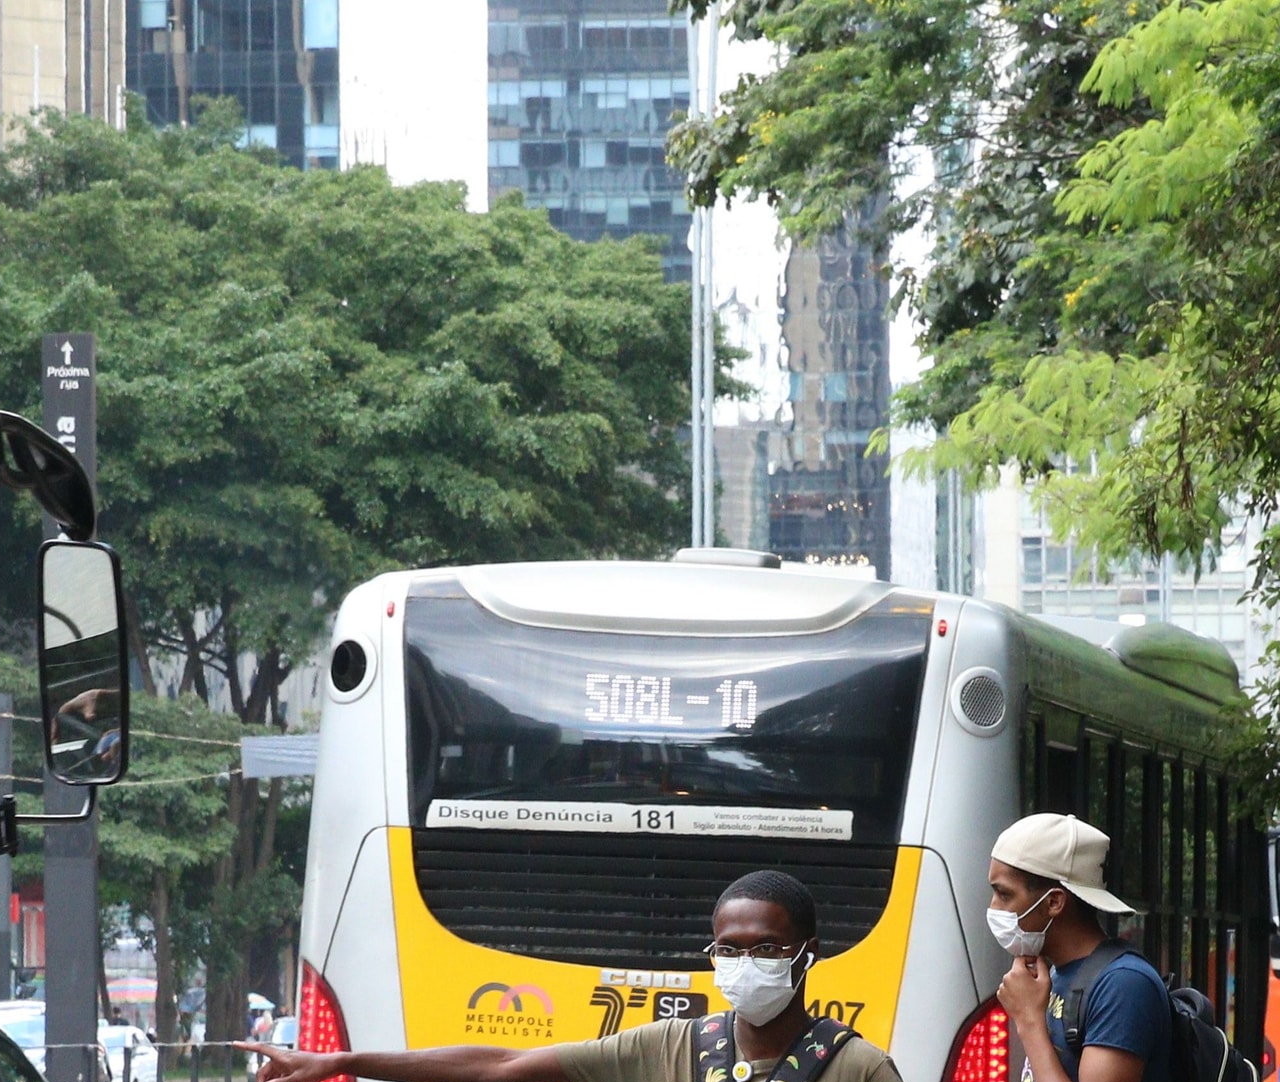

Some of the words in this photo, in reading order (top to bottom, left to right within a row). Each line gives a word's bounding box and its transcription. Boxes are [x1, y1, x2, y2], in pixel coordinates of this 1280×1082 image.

[46, 365, 91, 378] Próxima
[438, 804, 509, 823] Disque
[516, 806, 614, 824] Denúncia
[631, 809, 677, 831] 181
[714, 811, 740, 821] Vamos
[742, 813, 779, 822] combater
[788, 813, 823, 824] violência
[693, 821, 715, 831] Sigilo
[717, 822, 752, 831] absoluto
[758, 823, 808, 833] Atendimento
[809, 825, 819, 833] 24
[821, 825, 844, 834] horas
[658, 995, 691, 1018] SP
[465, 1013, 554, 1028] METROPOLE
[465, 1024, 554, 1039] PAULISTA
